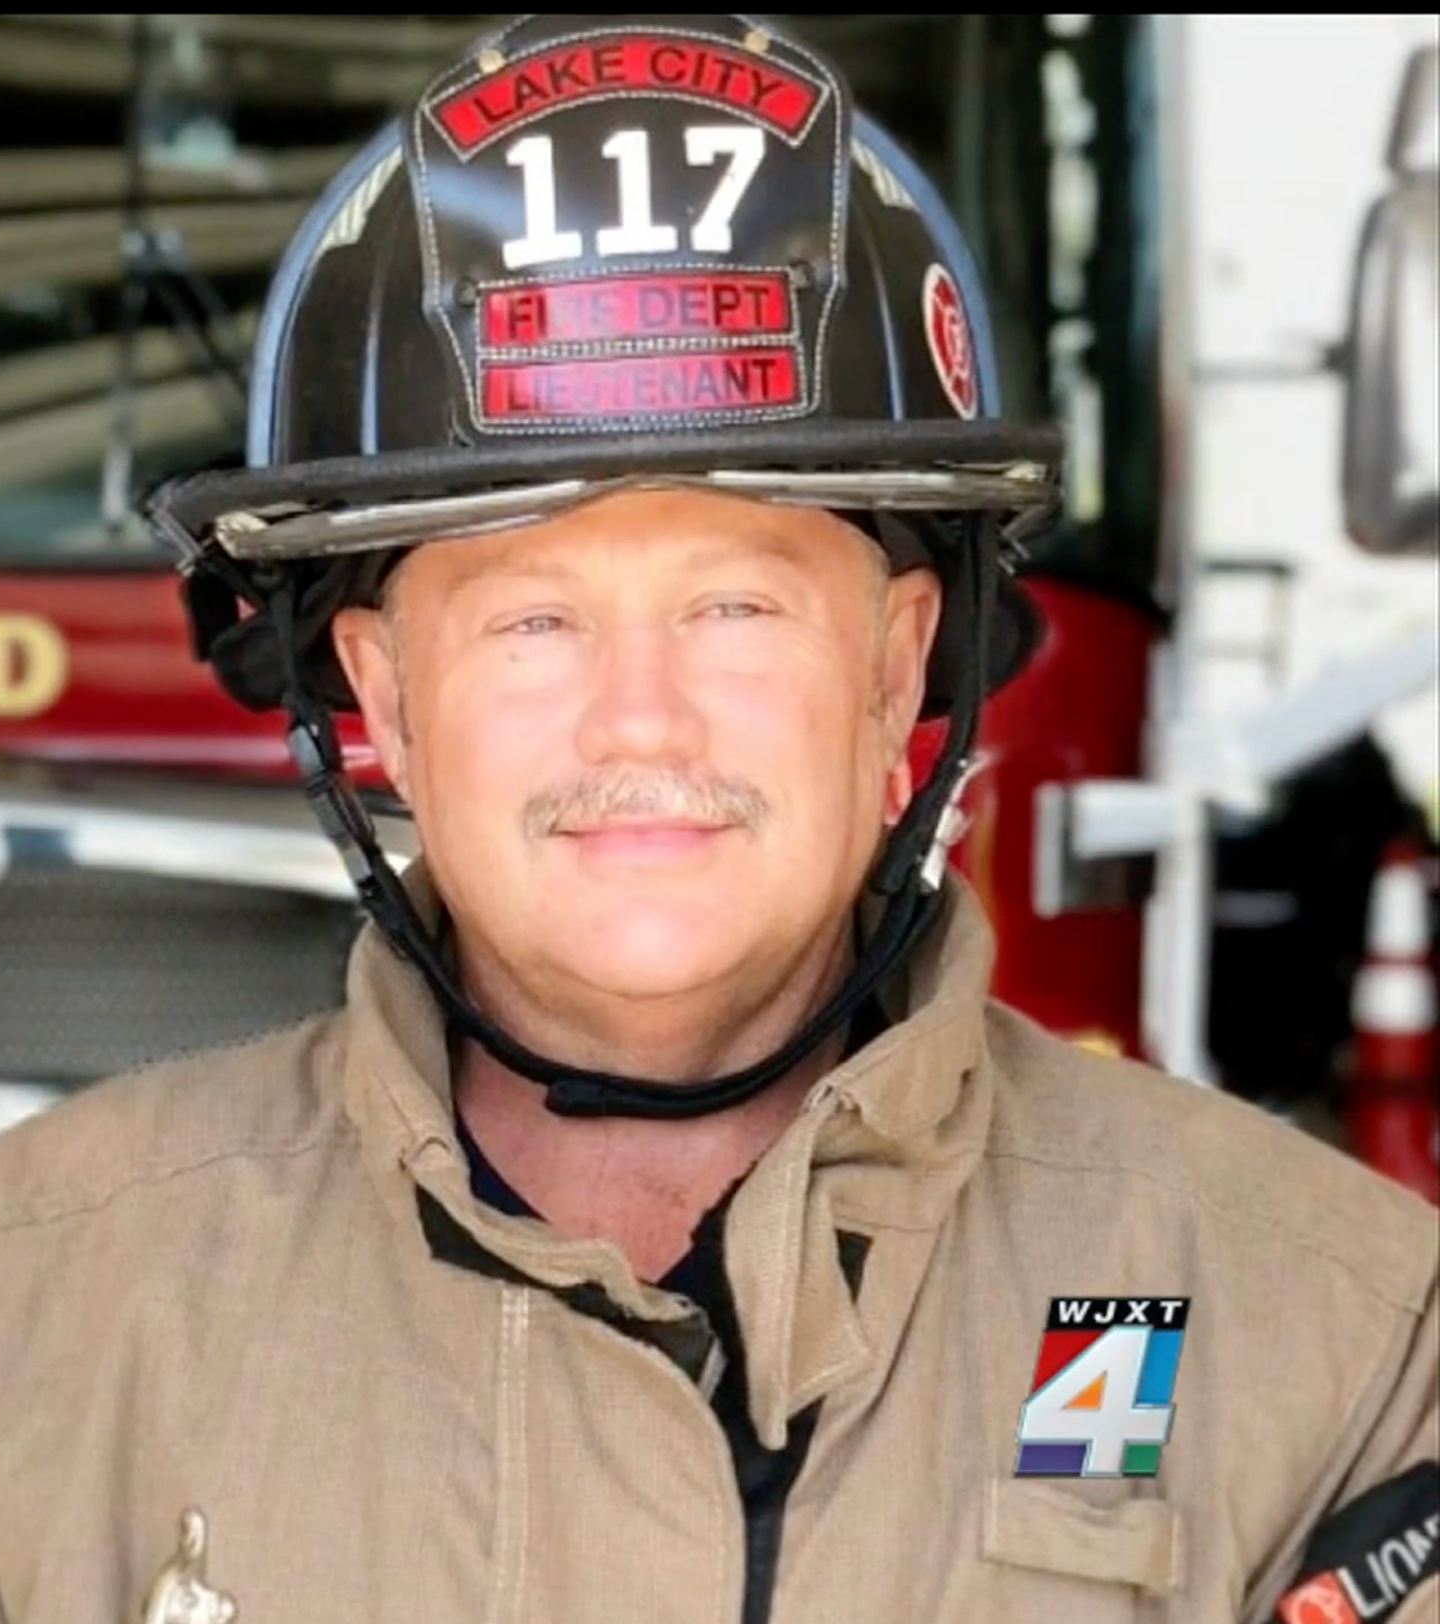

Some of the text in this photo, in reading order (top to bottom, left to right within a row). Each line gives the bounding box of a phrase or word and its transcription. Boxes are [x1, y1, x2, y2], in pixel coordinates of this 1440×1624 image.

[472, 45, 788, 124] LAKE CITY
[502, 126, 765, 269] 117
[638, 283, 769, 328] DEPT
[507, 358, 775, 411] LIEUTENANT
